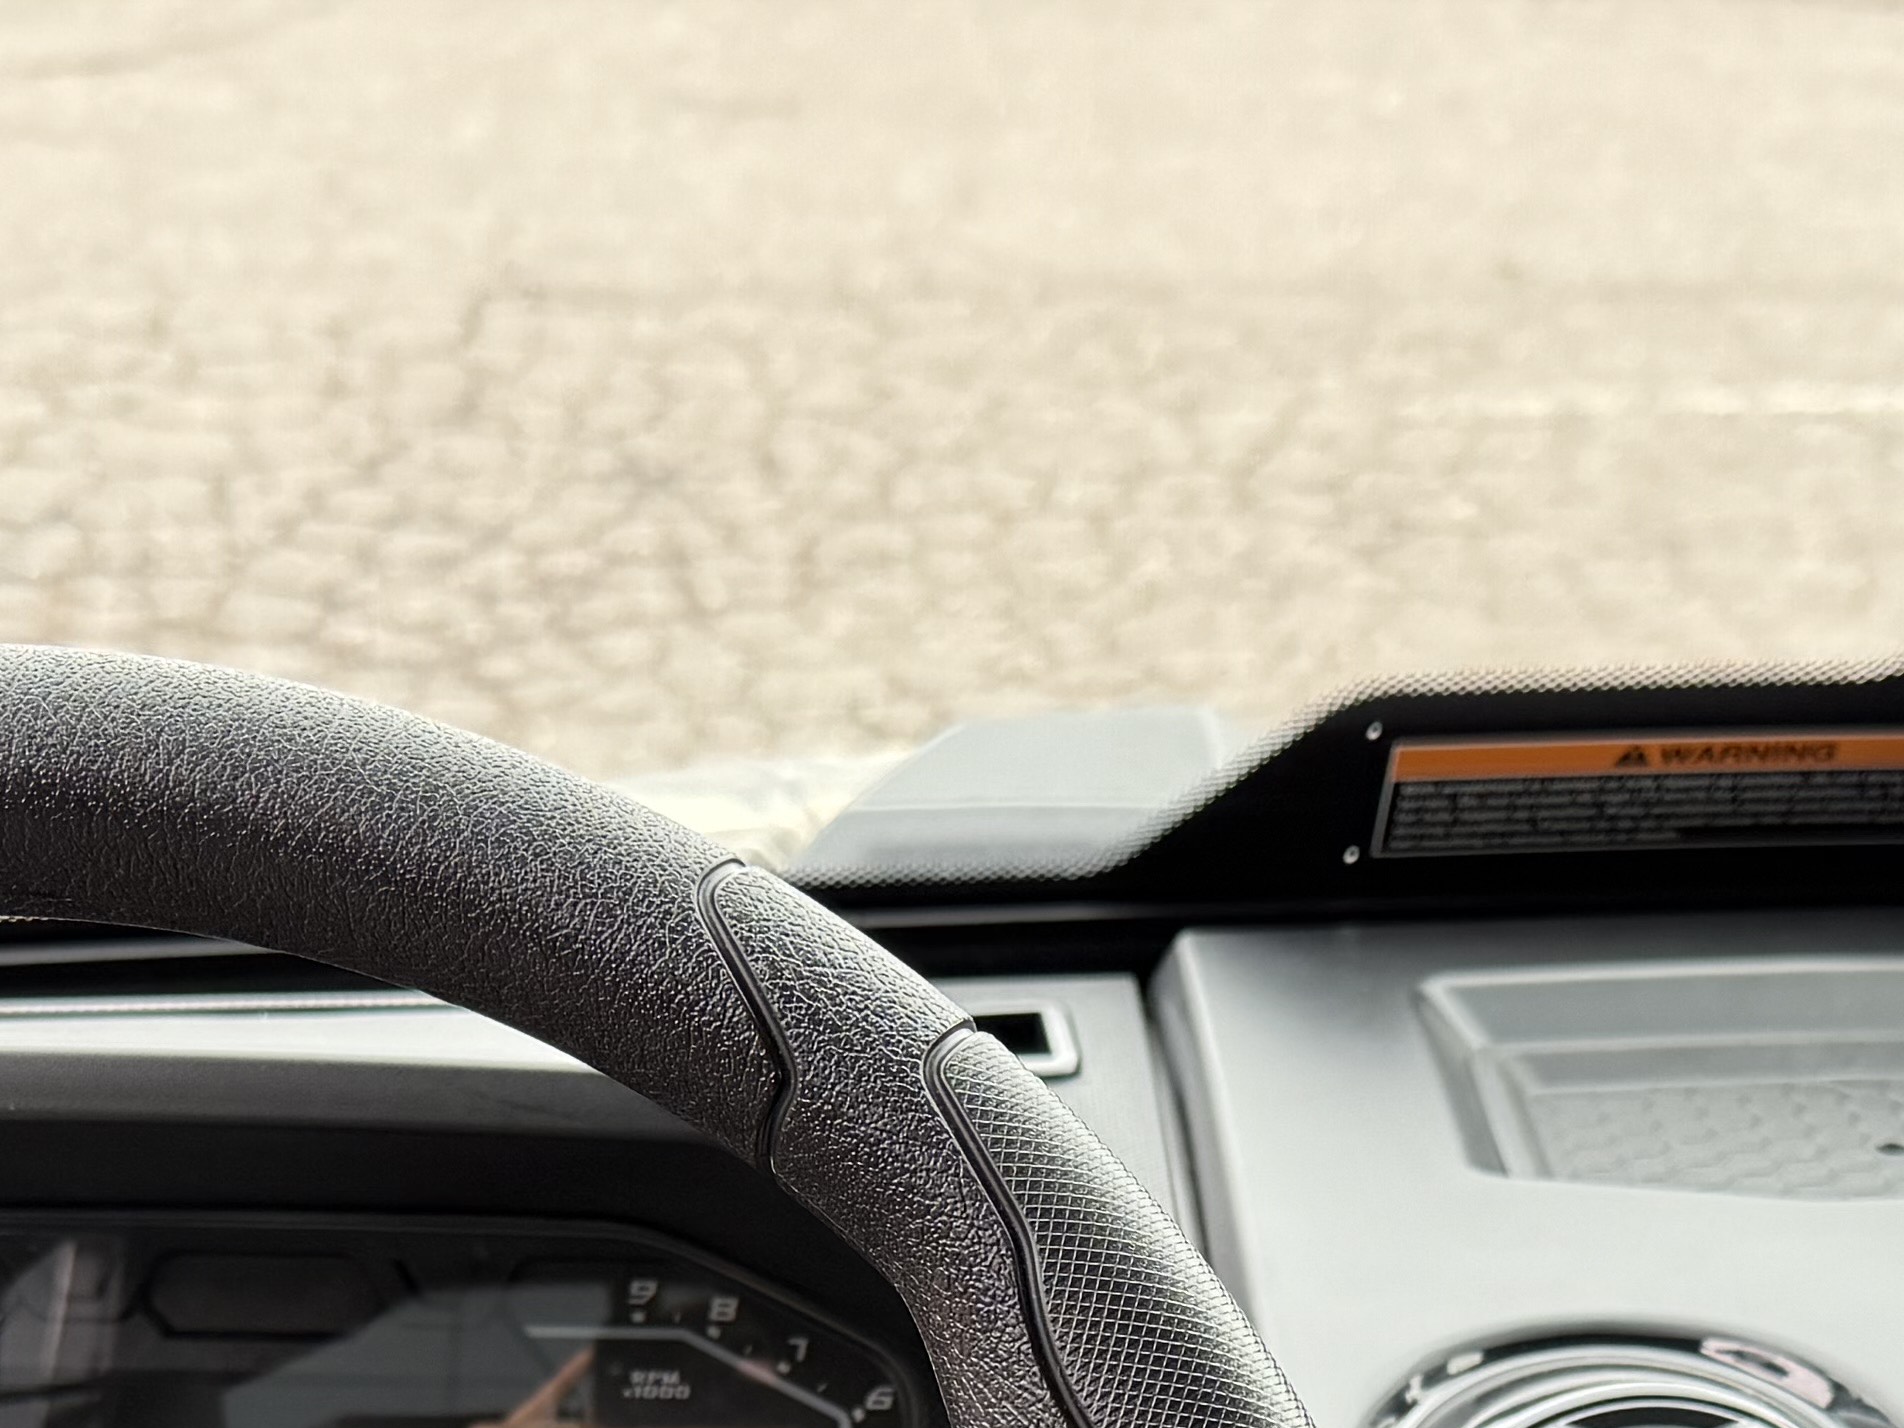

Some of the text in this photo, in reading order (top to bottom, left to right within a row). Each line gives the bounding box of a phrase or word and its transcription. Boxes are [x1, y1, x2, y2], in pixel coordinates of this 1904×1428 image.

[1661, 741, 1838, 765] WARNING
[628, 1279, 658, 1304] 9
[708, 1297, 739, 1322] 8
[787, 1336, 810, 1362] 7
[865, 1385, 895, 1410] 6
